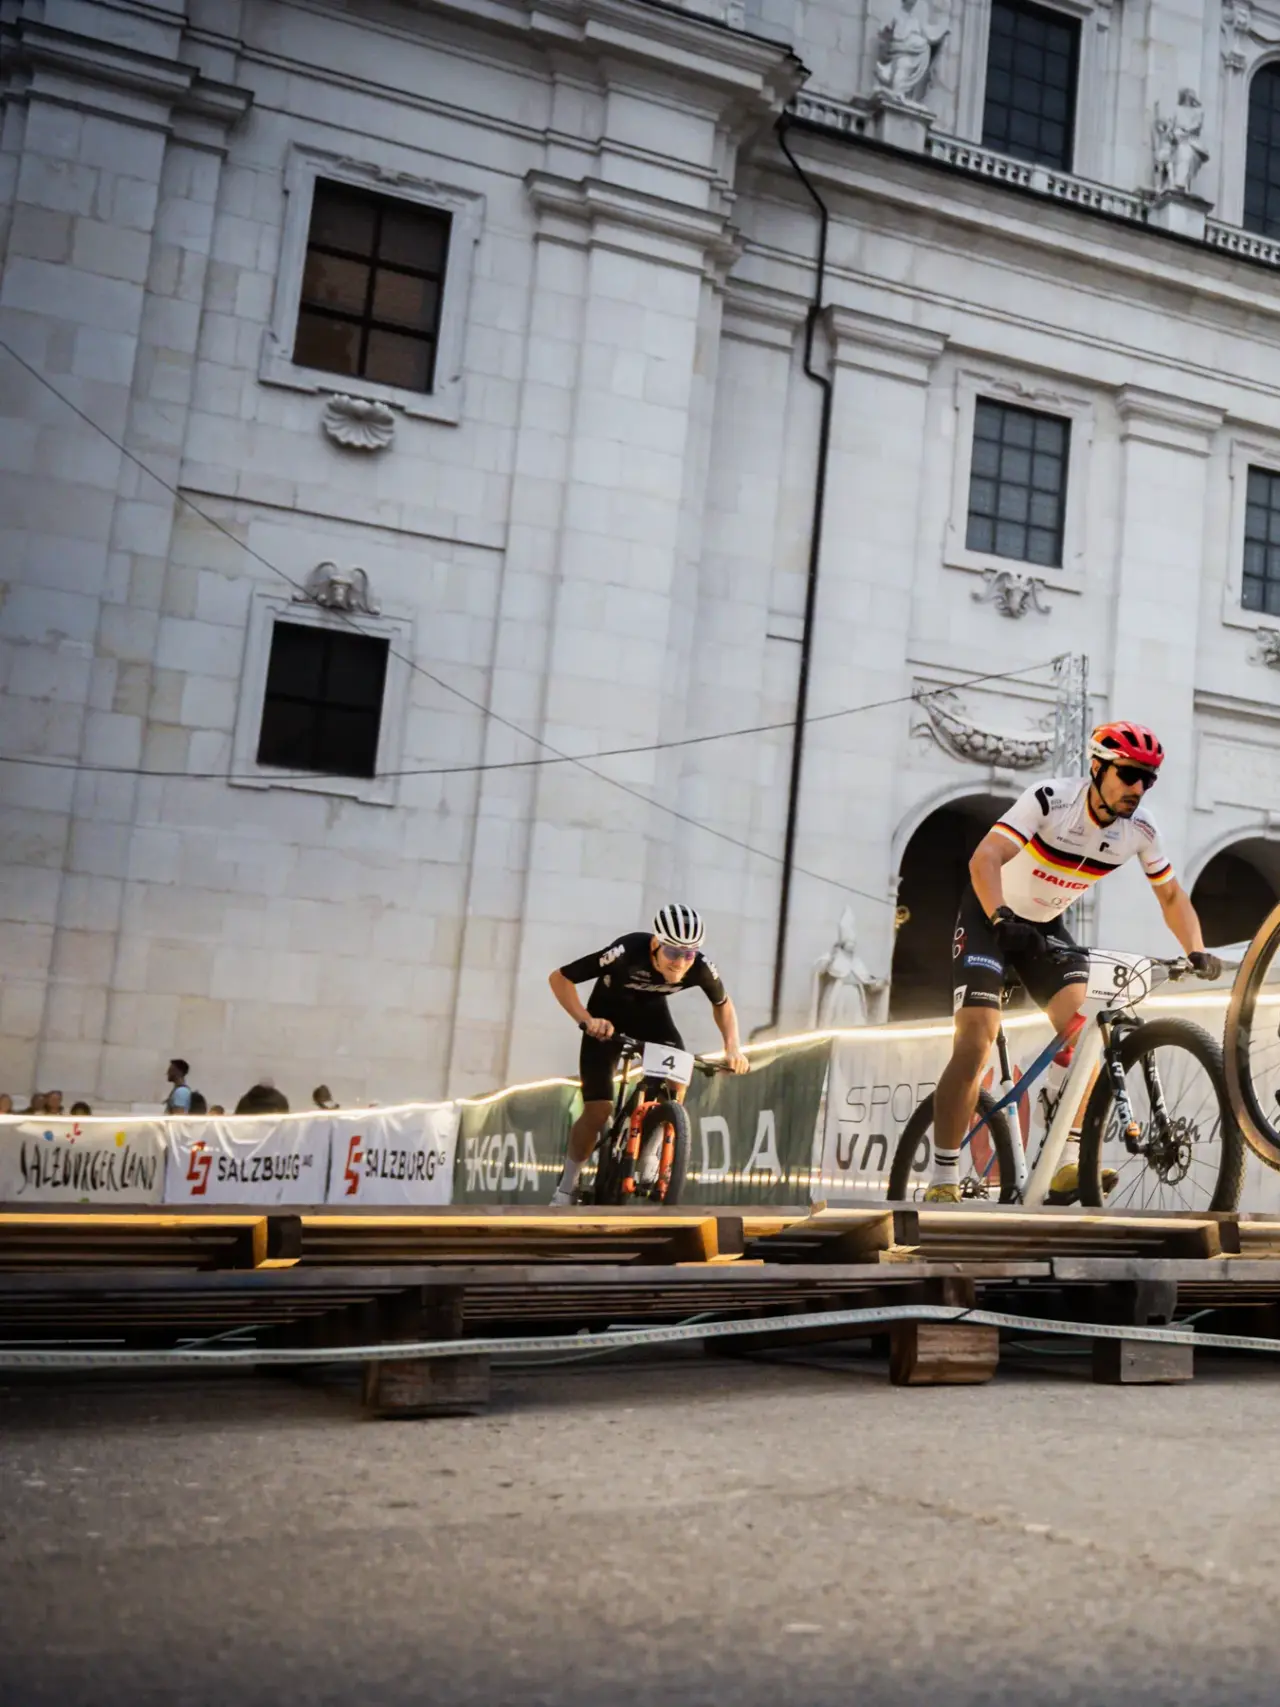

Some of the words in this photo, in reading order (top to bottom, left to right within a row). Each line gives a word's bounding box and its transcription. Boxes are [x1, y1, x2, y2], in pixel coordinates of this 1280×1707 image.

[1113, 964, 1128, 987] 8
[662, 1055, 675, 1070] 4
[365, 1149, 436, 1181] SALZBURG
